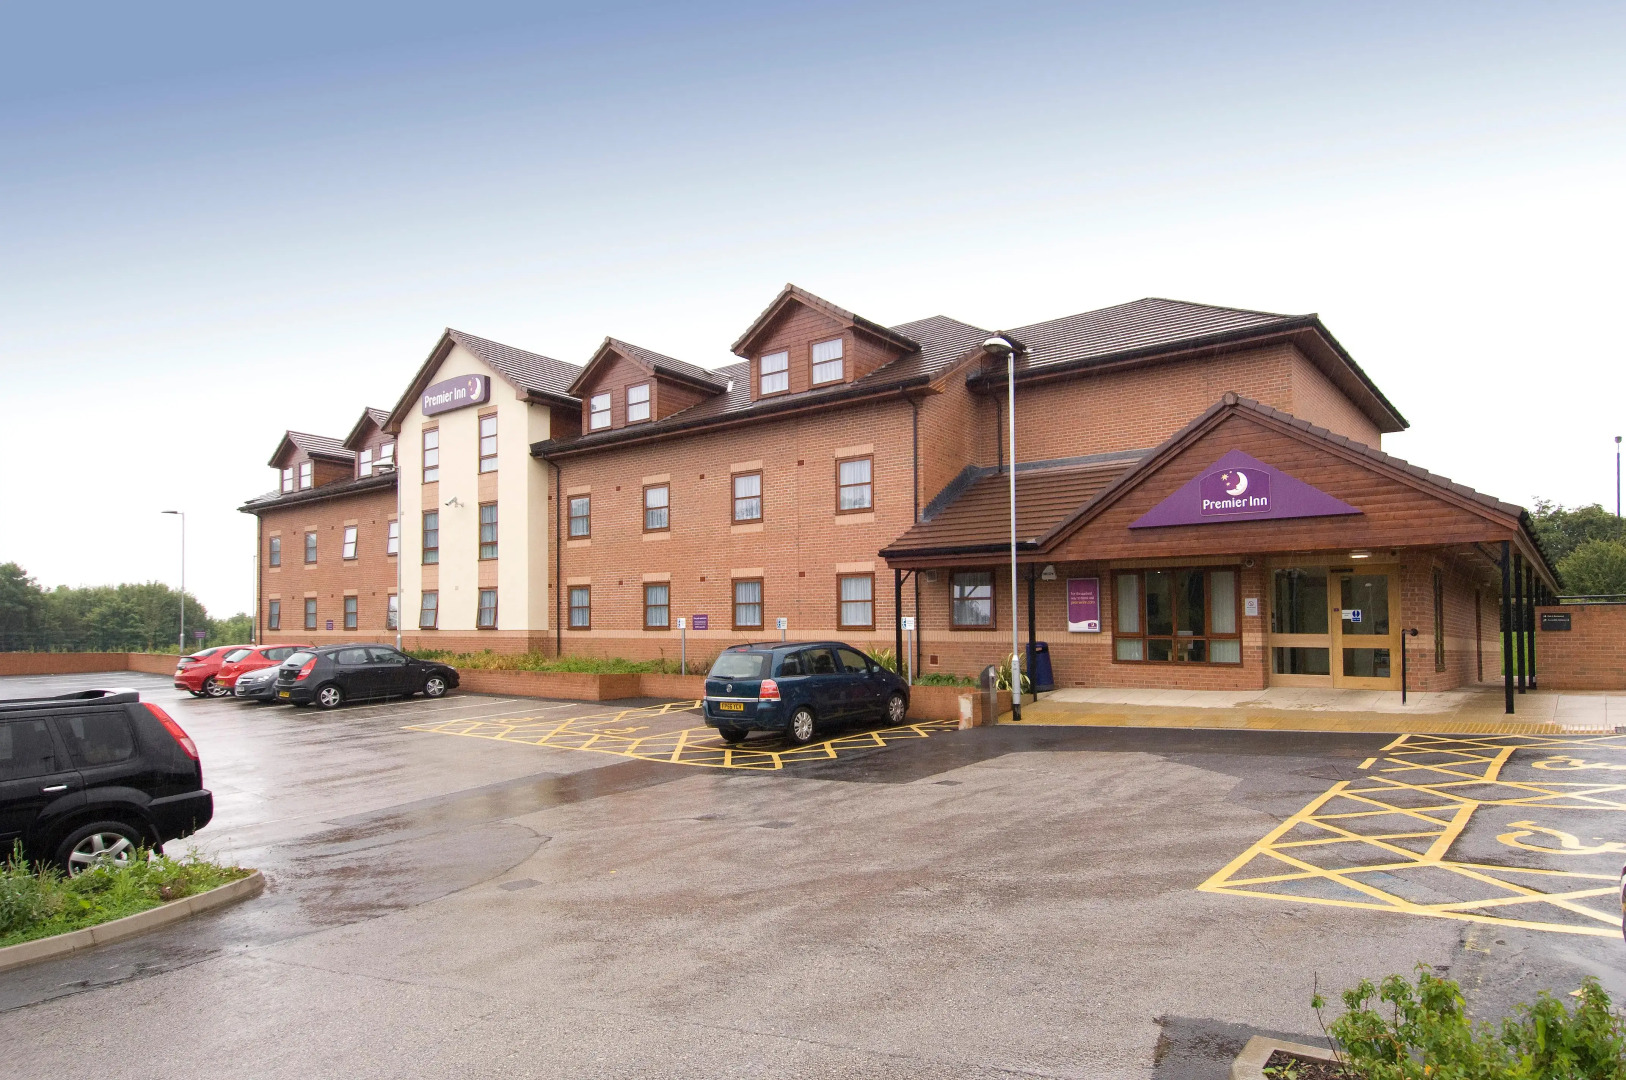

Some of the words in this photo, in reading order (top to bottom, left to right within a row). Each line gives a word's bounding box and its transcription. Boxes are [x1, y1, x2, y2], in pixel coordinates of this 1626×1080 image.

[424, 390, 453, 408] Premier
[454, 387, 466, 400] Inn
[1202, 497, 1248, 510] Premier
[1249, 495, 1268, 507] Inn
